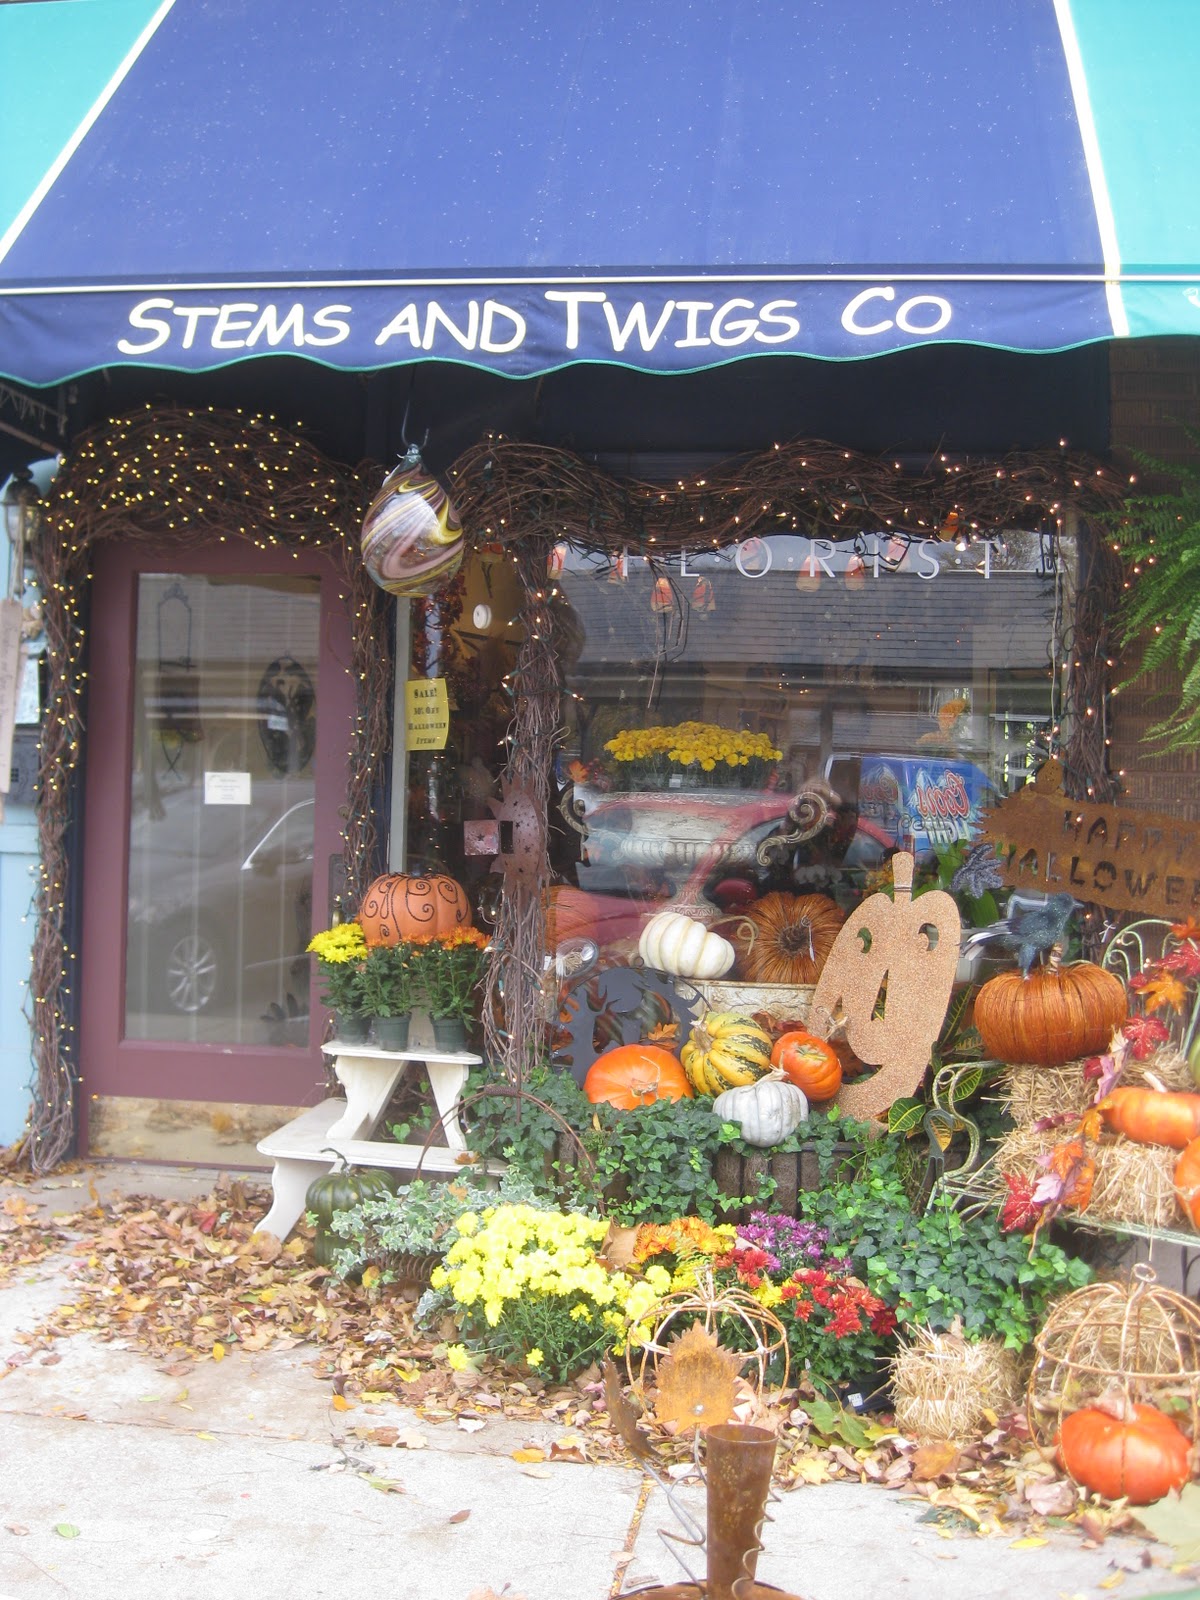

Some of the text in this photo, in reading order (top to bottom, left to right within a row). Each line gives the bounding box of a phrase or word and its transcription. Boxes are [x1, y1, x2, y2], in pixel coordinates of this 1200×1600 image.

[117, 286, 953, 355] STEMS AND TWIGS CO
[1063, 810, 1196, 861] HAPPY
